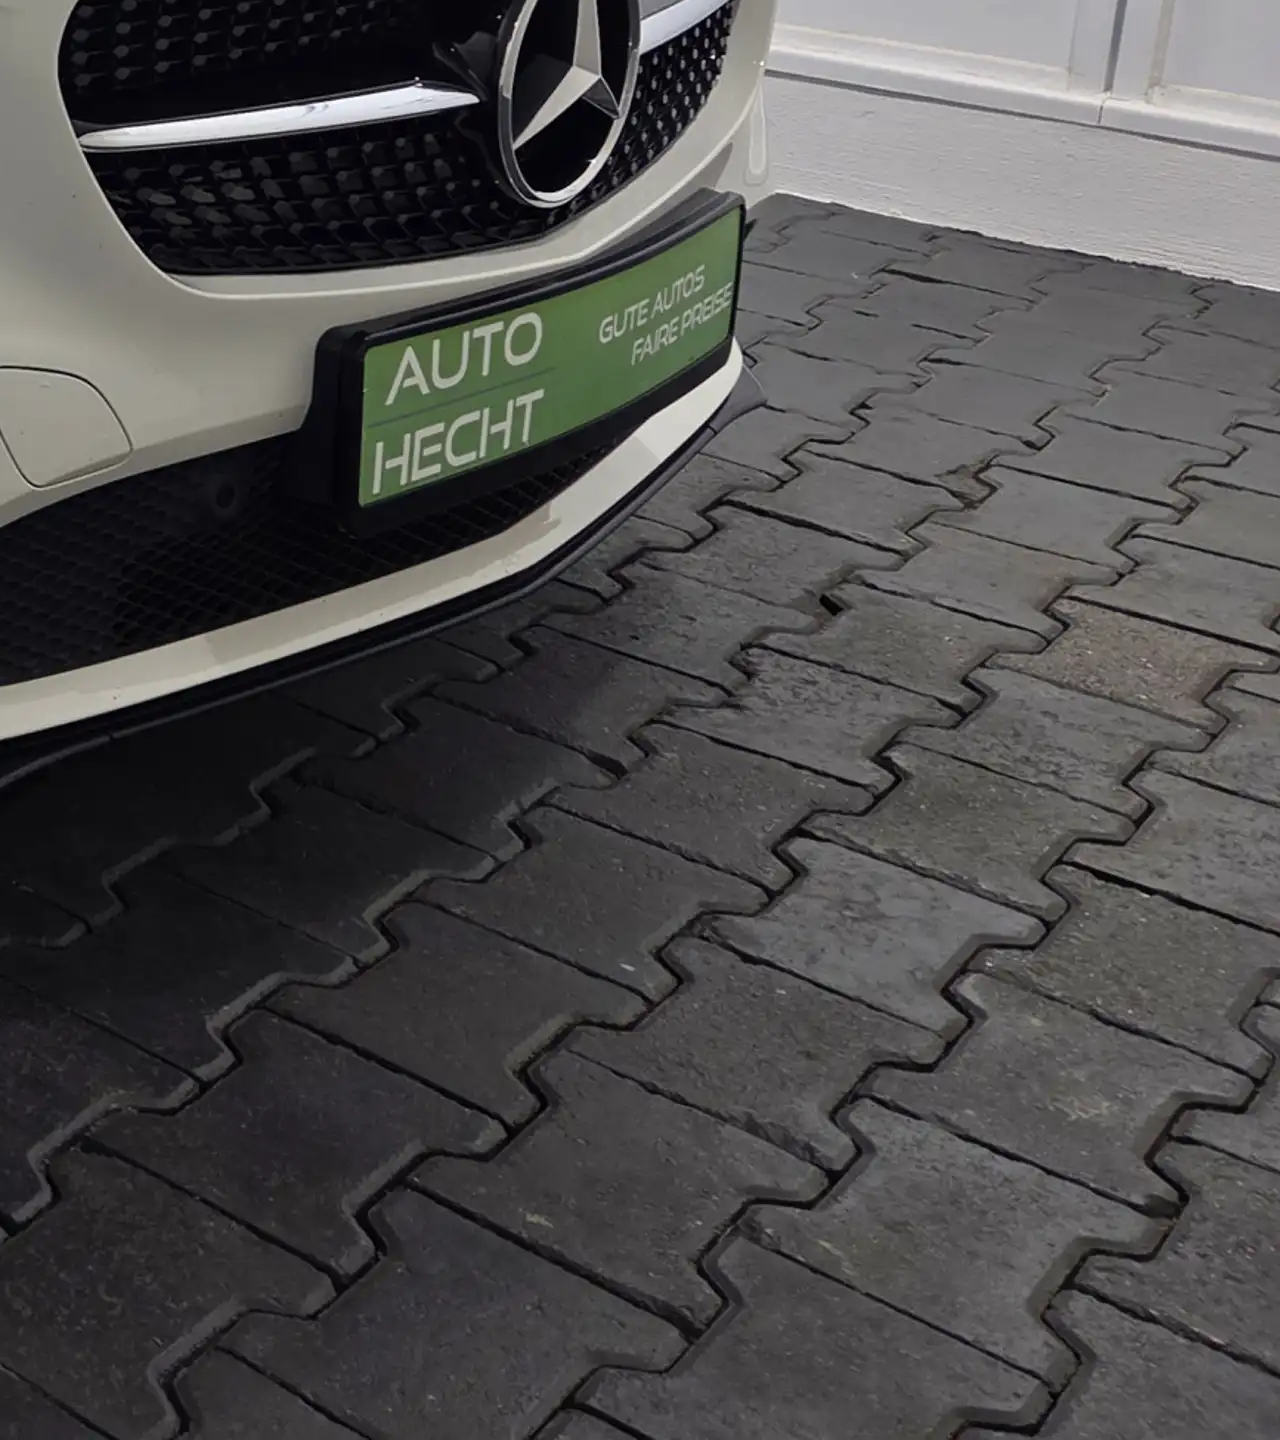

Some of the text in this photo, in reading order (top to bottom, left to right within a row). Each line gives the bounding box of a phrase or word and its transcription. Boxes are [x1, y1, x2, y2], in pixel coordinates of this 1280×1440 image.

[599, 264, 705, 344] GUTE AUTOS
[631, 282, 733, 366] FAIRE PREISE
[385, 312, 543, 406] AUTO
[372, 389, 544, 495] HECHT
